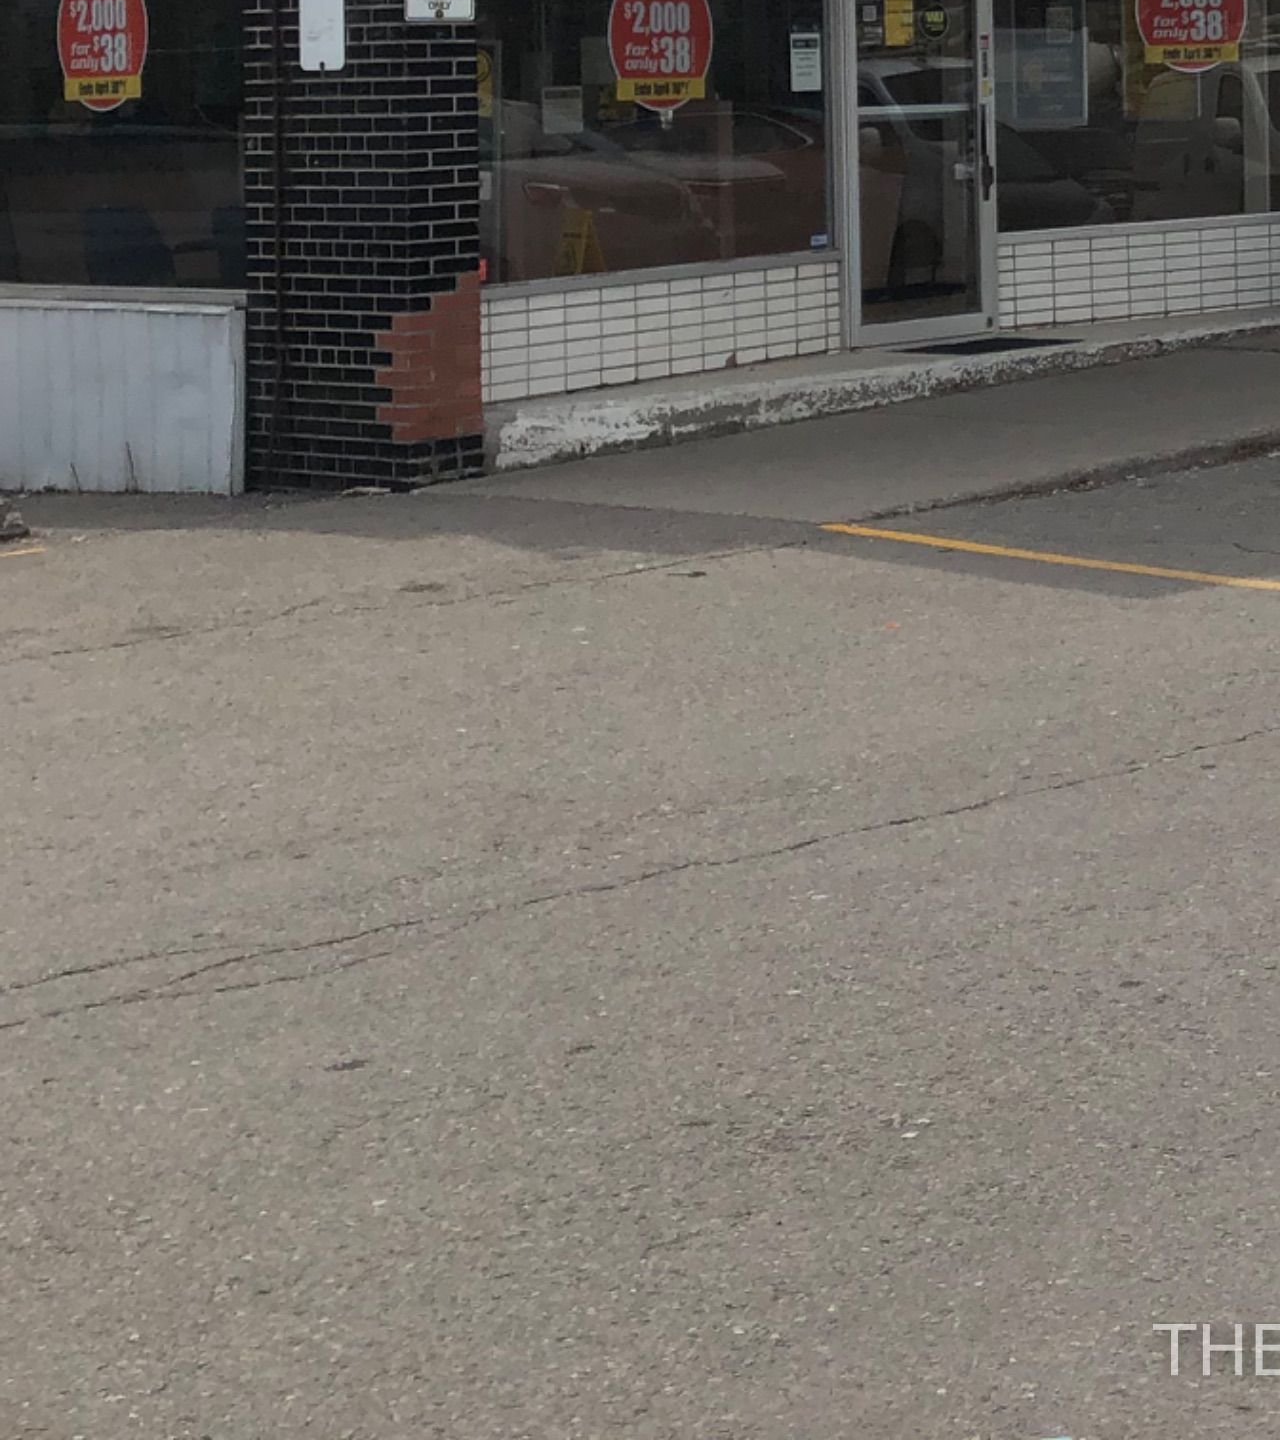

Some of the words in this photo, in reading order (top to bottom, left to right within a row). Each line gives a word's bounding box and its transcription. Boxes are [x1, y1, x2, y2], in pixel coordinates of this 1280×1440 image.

[624, 1, 690, 35] $2,000
[1153, 16, 1178, 28] for
[1181, 10, 1223, 40] $38
[1152, 28, 1188, 40] only
[70, 56, 100, 72] only
[71, 42, 90, 57] for
[93, 33, 126, 72] $38
[624, 58, 658, 73] only
[625, 41, 649, 55] for
[651, 36, 690, 73] $38
